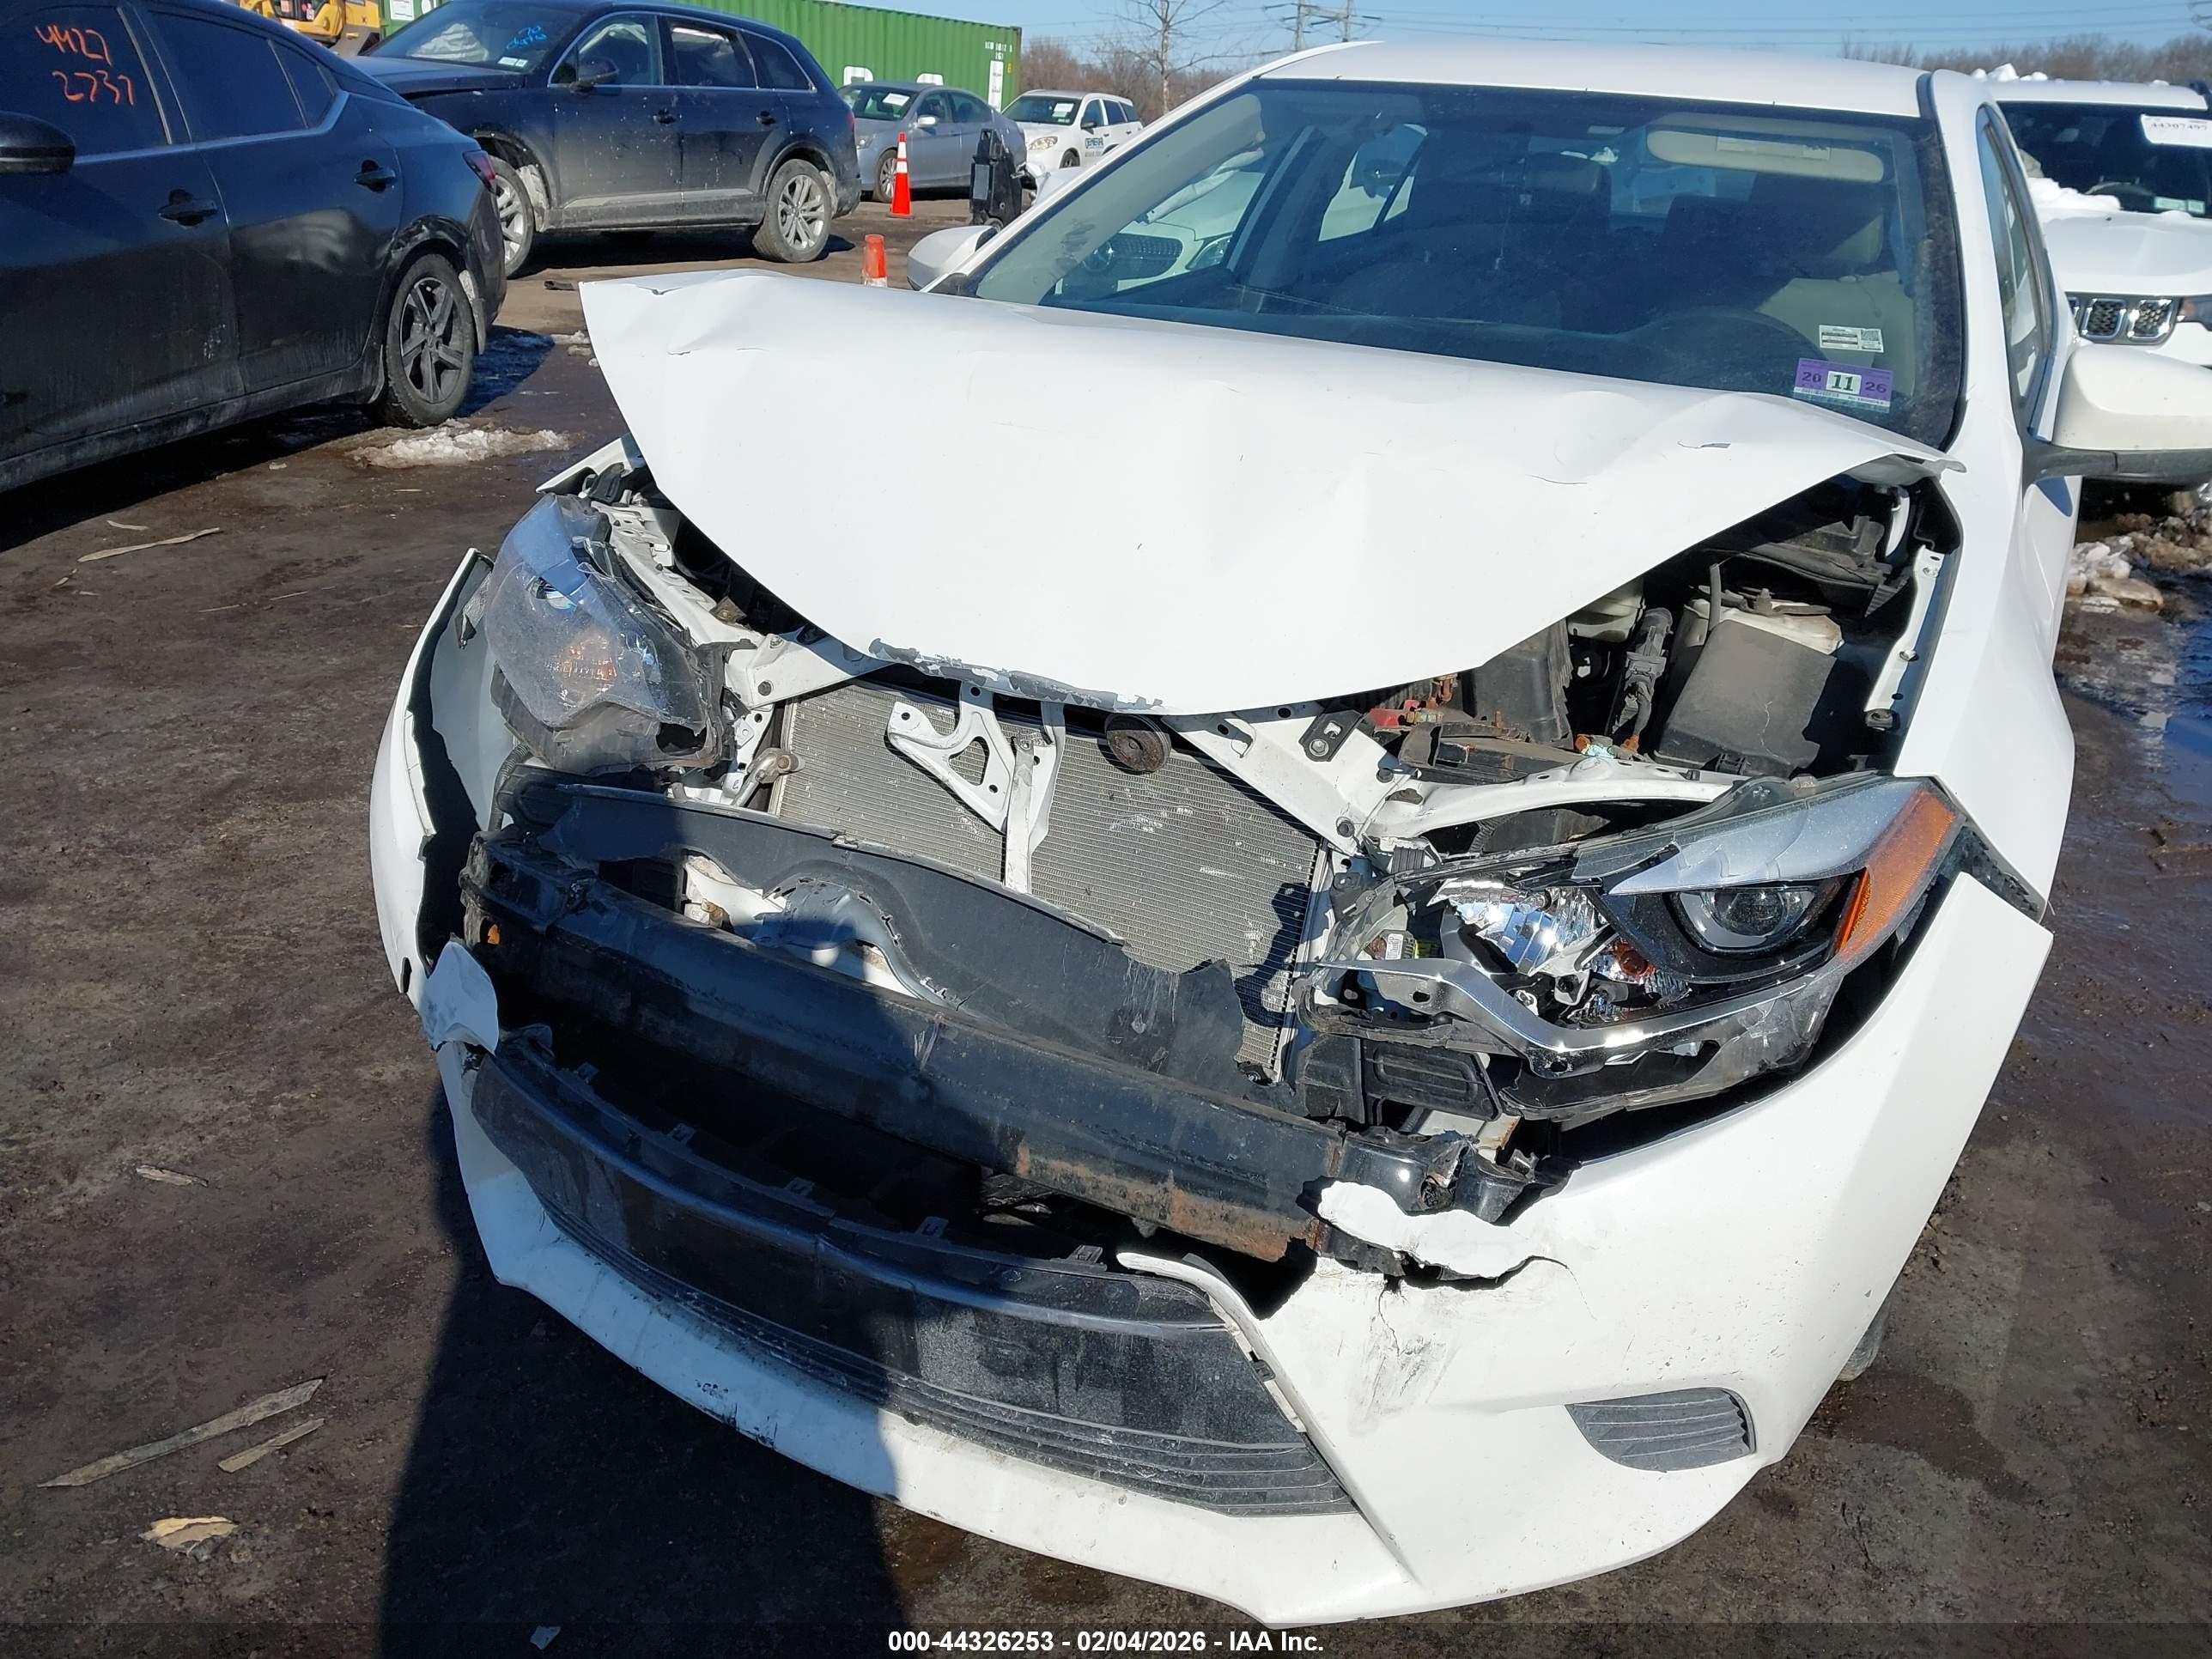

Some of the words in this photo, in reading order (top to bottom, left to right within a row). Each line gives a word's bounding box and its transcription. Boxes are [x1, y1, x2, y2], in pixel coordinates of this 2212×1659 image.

[34, 25, 112, 66] 4427
[52, 70, 134, 106] 2737
[1802, 371, 1822, 383] 20
[1831, 374, 1855, 392] 11
[1865, 381, 1887, 393] 26
